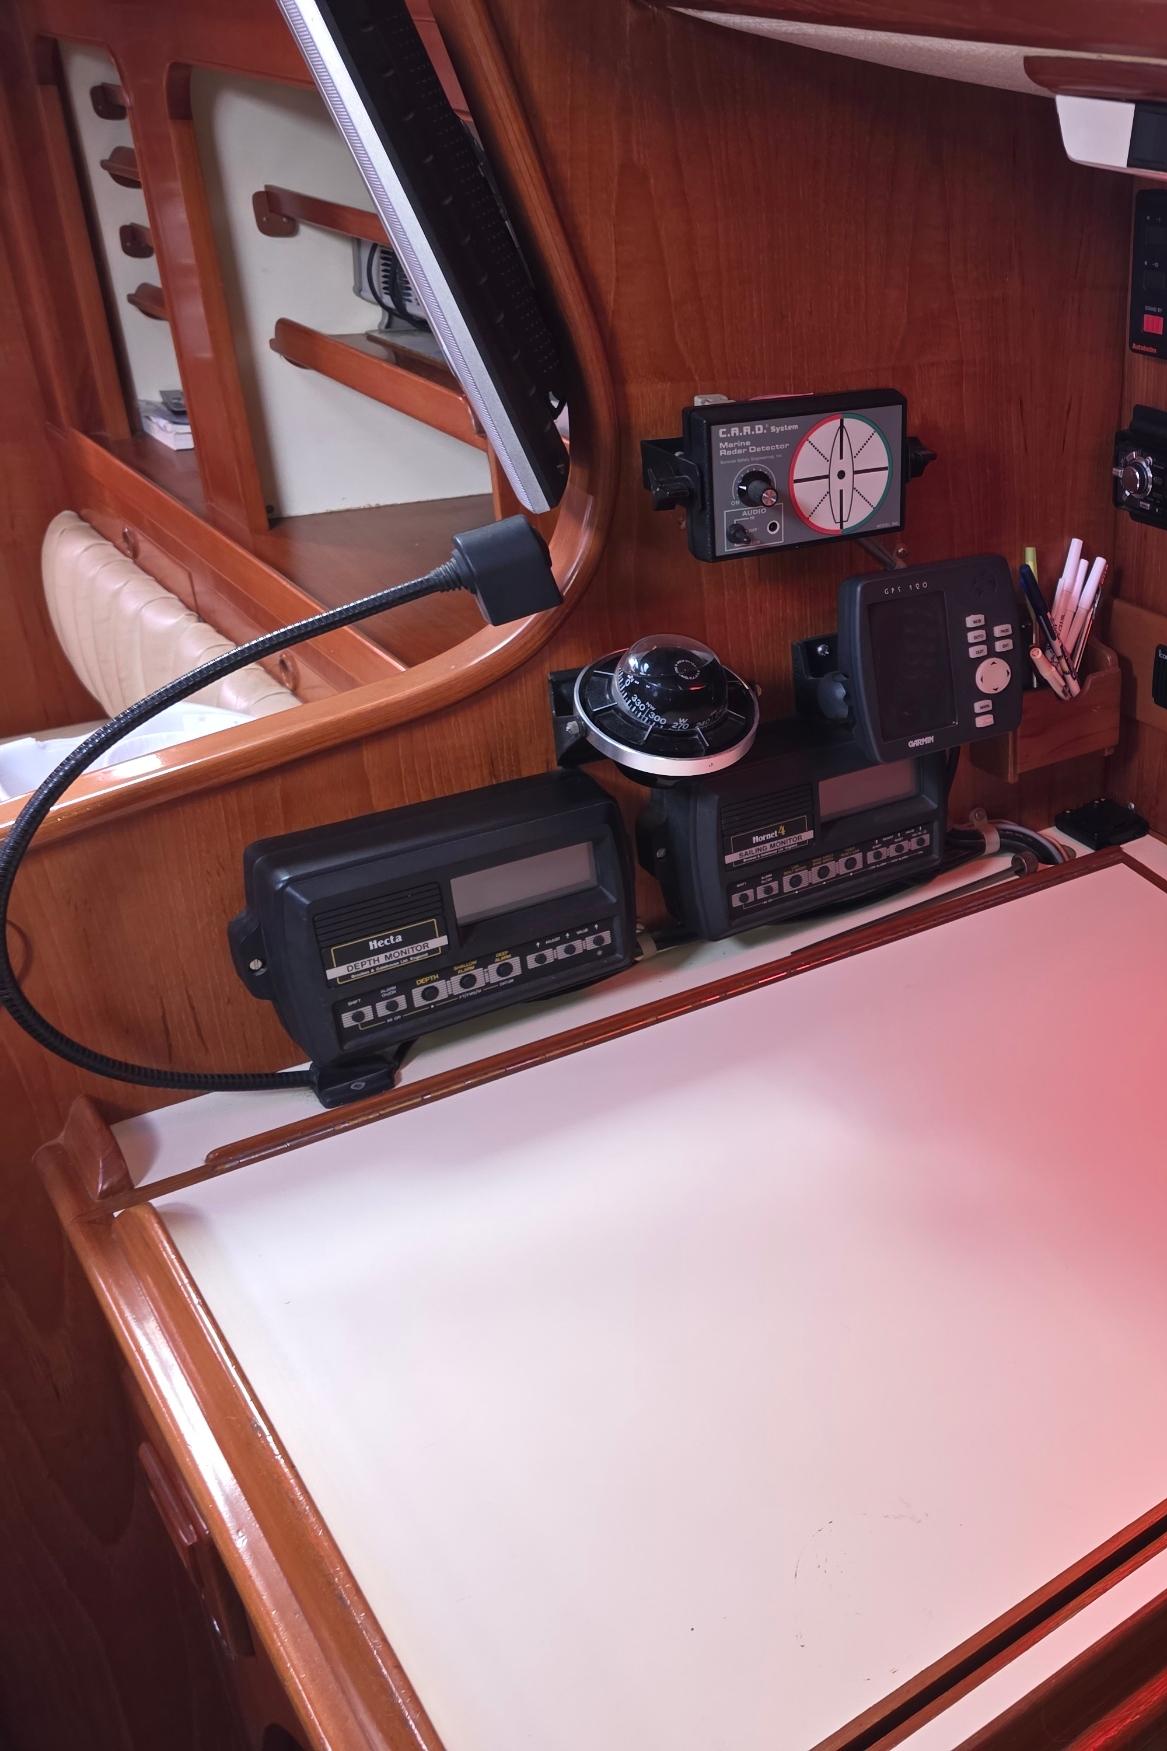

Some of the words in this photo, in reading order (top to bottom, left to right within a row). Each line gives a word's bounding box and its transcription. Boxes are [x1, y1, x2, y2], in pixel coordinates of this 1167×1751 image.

[770, 423, 798, 434] System
[719, 440, 751, 449] Marine
[719, 448, 748, 457] Radar
[749, 443, 790, 453] Detector
[742, 508, 767, 517] AUDIO
[631, 694, 646, 711] 330
[645, 701, 656, 711] NW
[649, 711, 667, 725] 300
[671, 722, 689, 730] 270
[908, 736, 934, 748] GARMIN
[752, 830, 778, 844] Hornet
[739, 845, 767, 858] SAILING
[769, 835, 803, 849] MONITOR
[368, 935, 403, 950] Hecta
[346, 956, 380, 973] DEPTH
[384, 942, 430, 961] MONITOR
[416, 974, 439, 986] DEPTH
